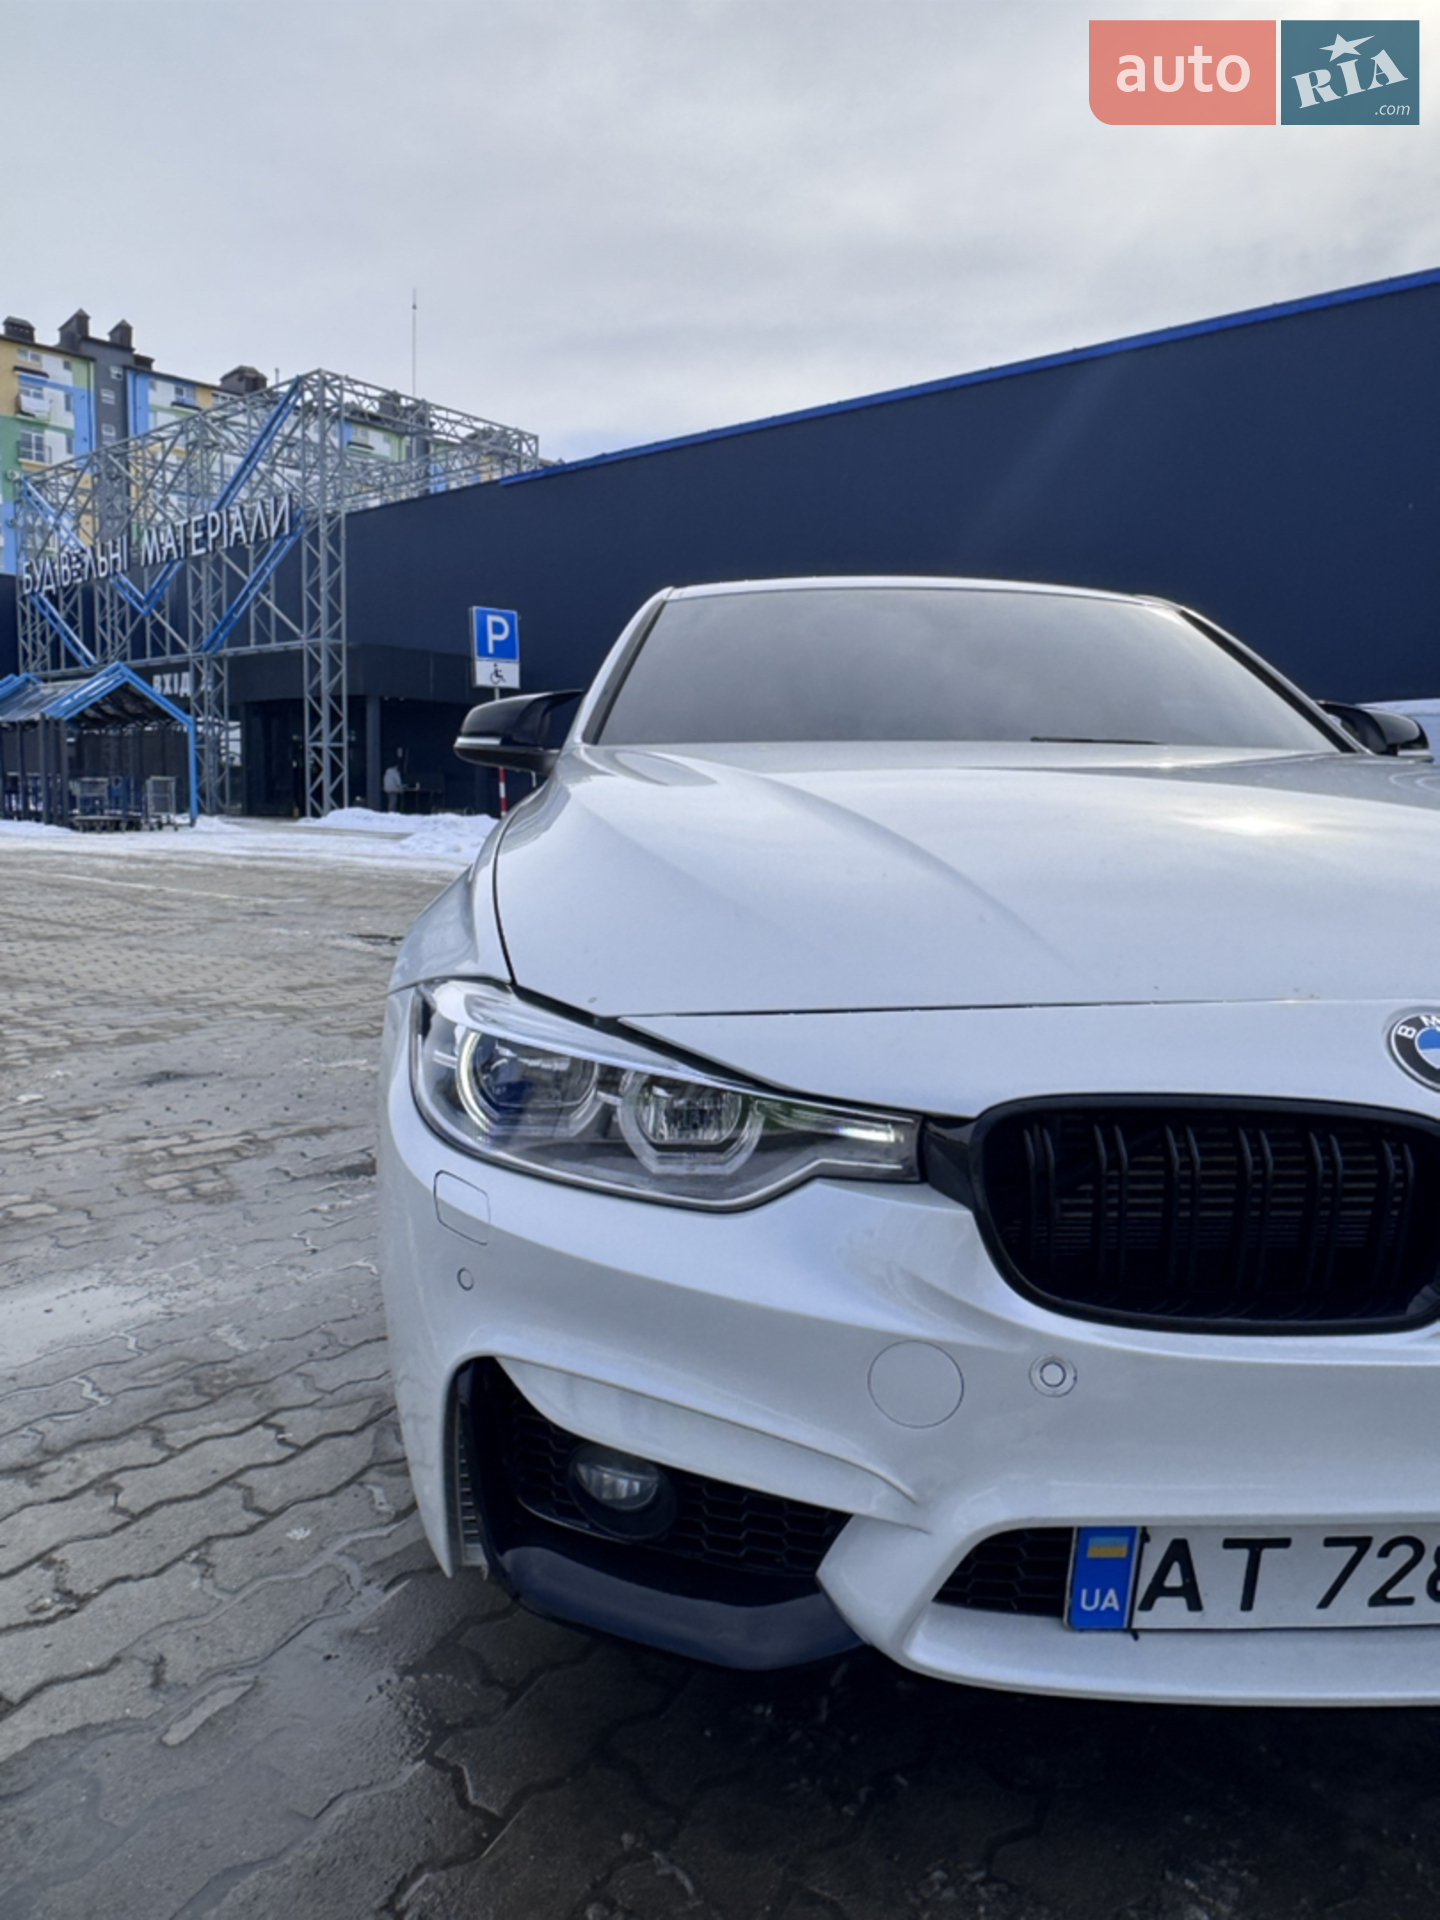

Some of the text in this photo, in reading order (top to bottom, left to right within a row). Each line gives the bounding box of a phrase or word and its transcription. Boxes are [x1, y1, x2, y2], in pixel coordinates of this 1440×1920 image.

[22, 494, 291, 595] БУДІВЕЛЬНІ МАТЕРІАЛИ
[487, 615, 509, 654] P
[1080, 1588, 1119, 1611] UA
[1138, 1537, 1291, 1611] AT
